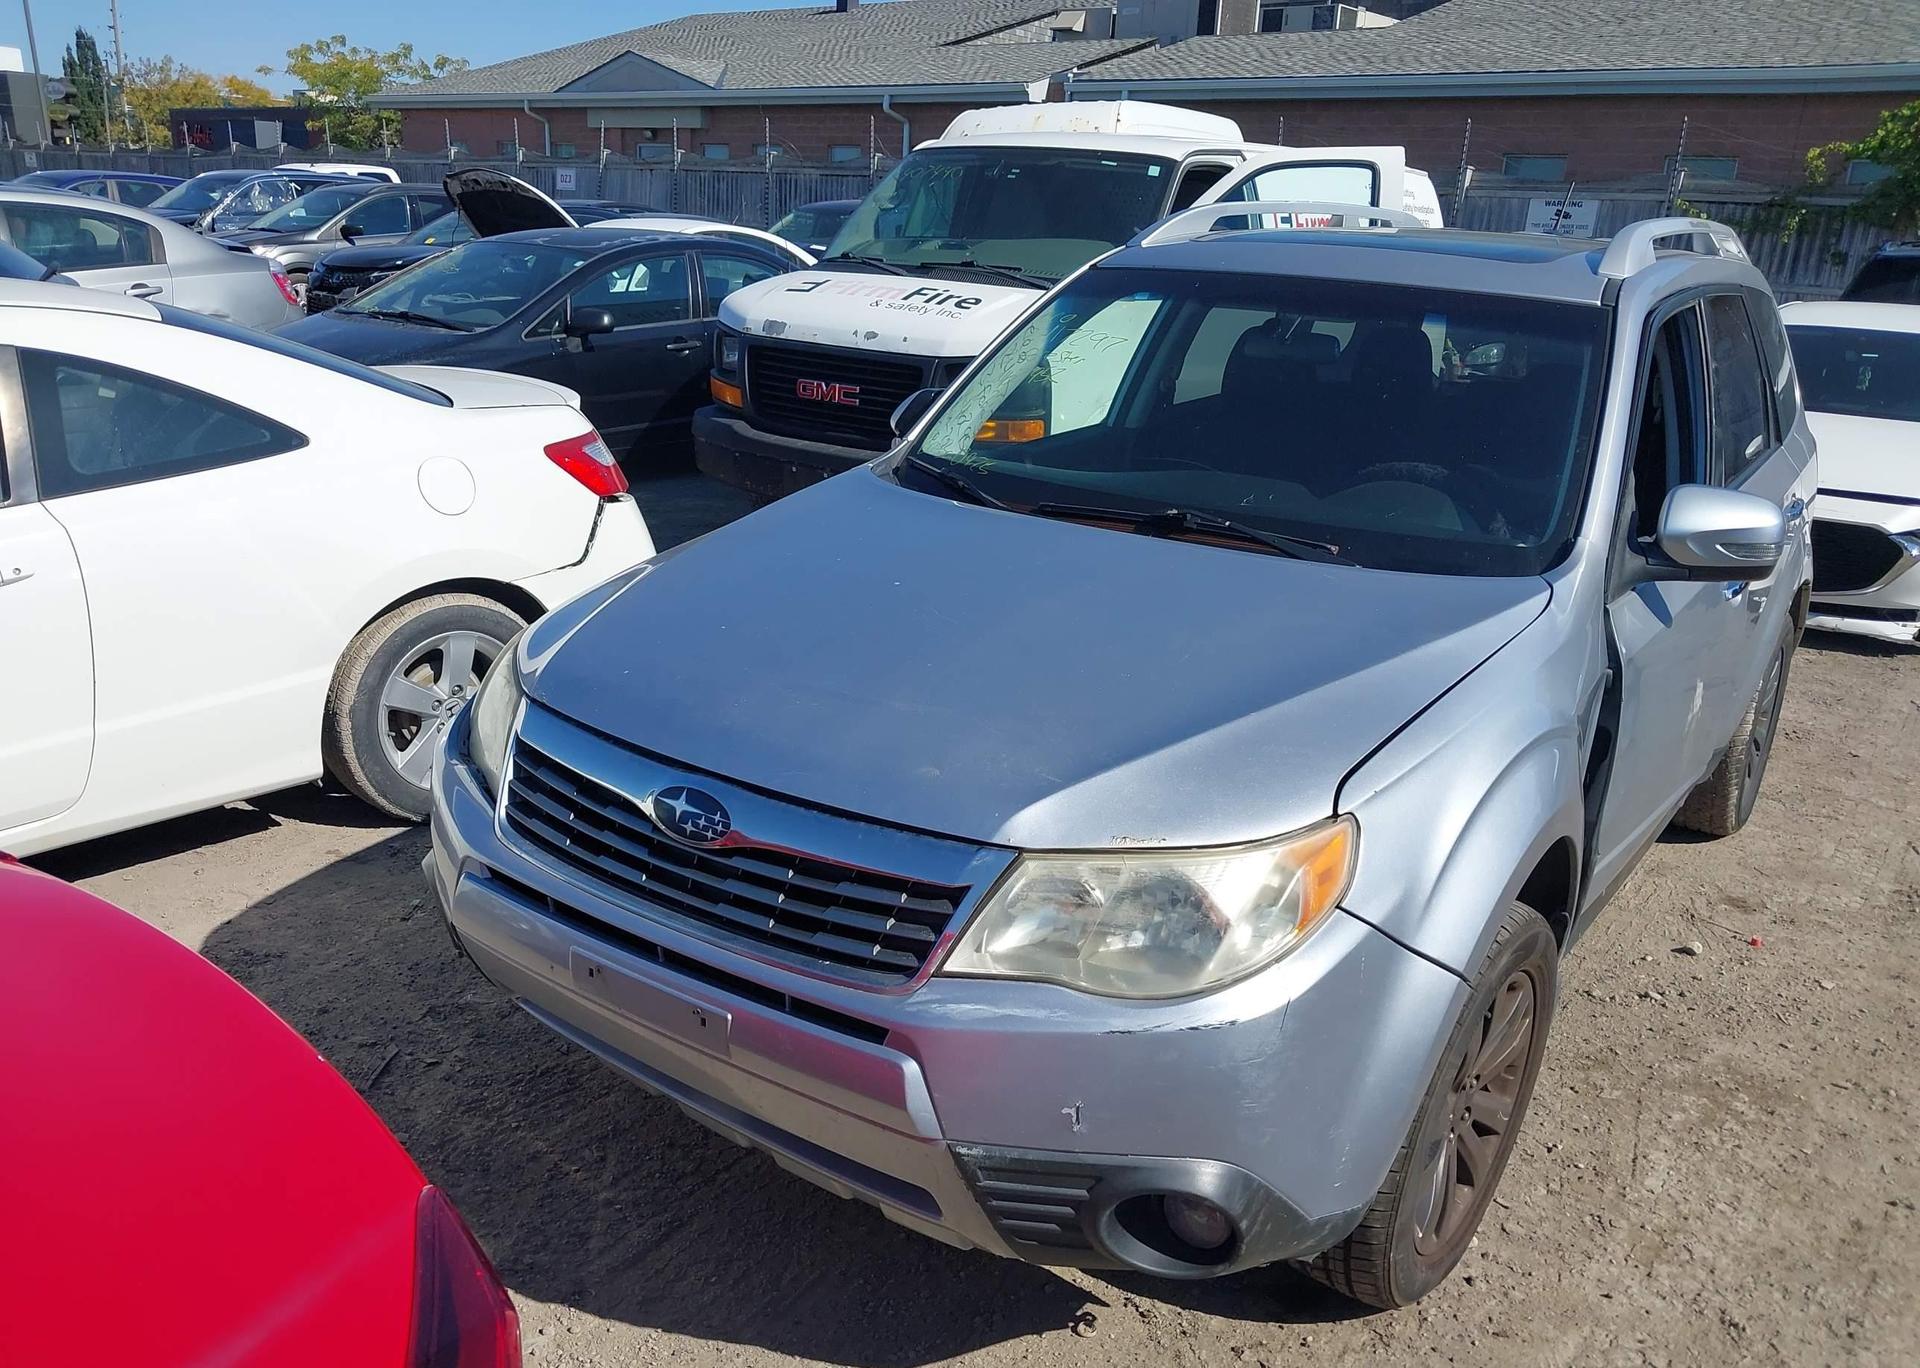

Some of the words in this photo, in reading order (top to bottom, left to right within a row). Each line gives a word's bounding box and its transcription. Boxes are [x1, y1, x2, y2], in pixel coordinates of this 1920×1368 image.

[1544, 199, 1584, 209] WARING
[885, 301, 934, 316] safety
[937, 307, 963, 320] Inc.
[797, 379, 860, 406] GMC
